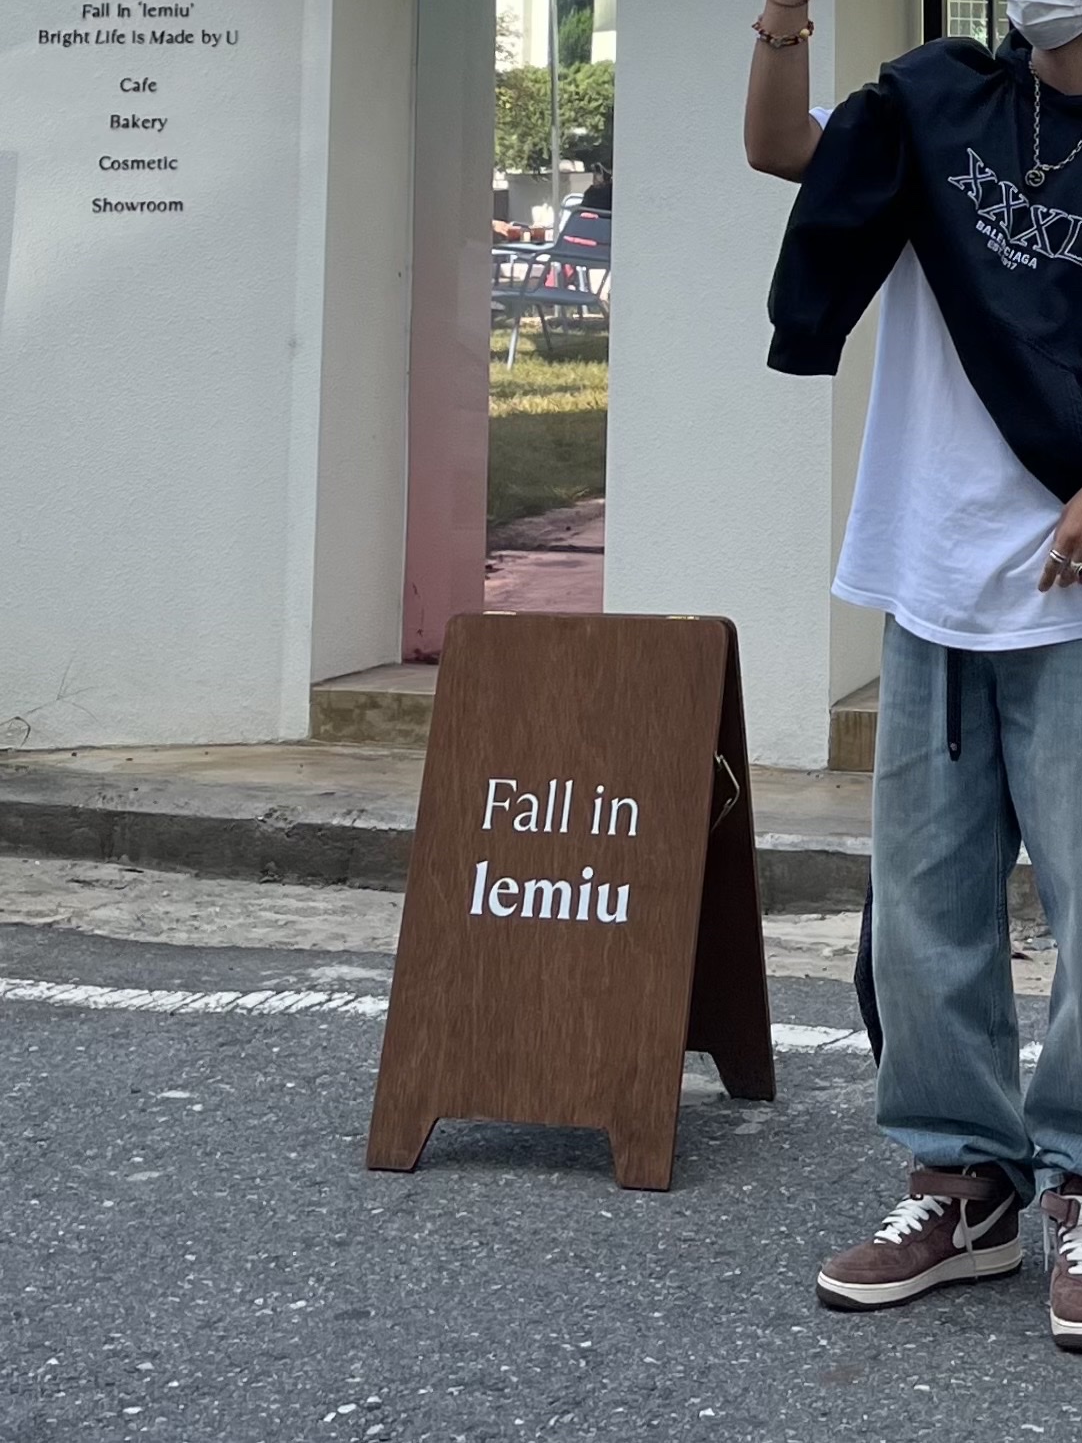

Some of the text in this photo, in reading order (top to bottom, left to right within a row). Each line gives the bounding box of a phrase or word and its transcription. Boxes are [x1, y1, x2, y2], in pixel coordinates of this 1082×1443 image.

[81, 3, 110, 20] Fall
[117, 3, 131, 18] In
[38, 30, 90, 47] Bright
[94, 29, 126, 45] Life
[149, 29, 194, 45] Made
[201, 29, 222, 47] by
[226, 30, 239, 45] U
[120, 77, 157, 93] Cafe
[110, 114, 168, 132] Bakery
[98, 155, 179, 171] Cosmetic
[91, 198, 183, 214] Showroom
[482, 778, 639, 836] Fall in
[470, 860, 630, 923] lemiu
